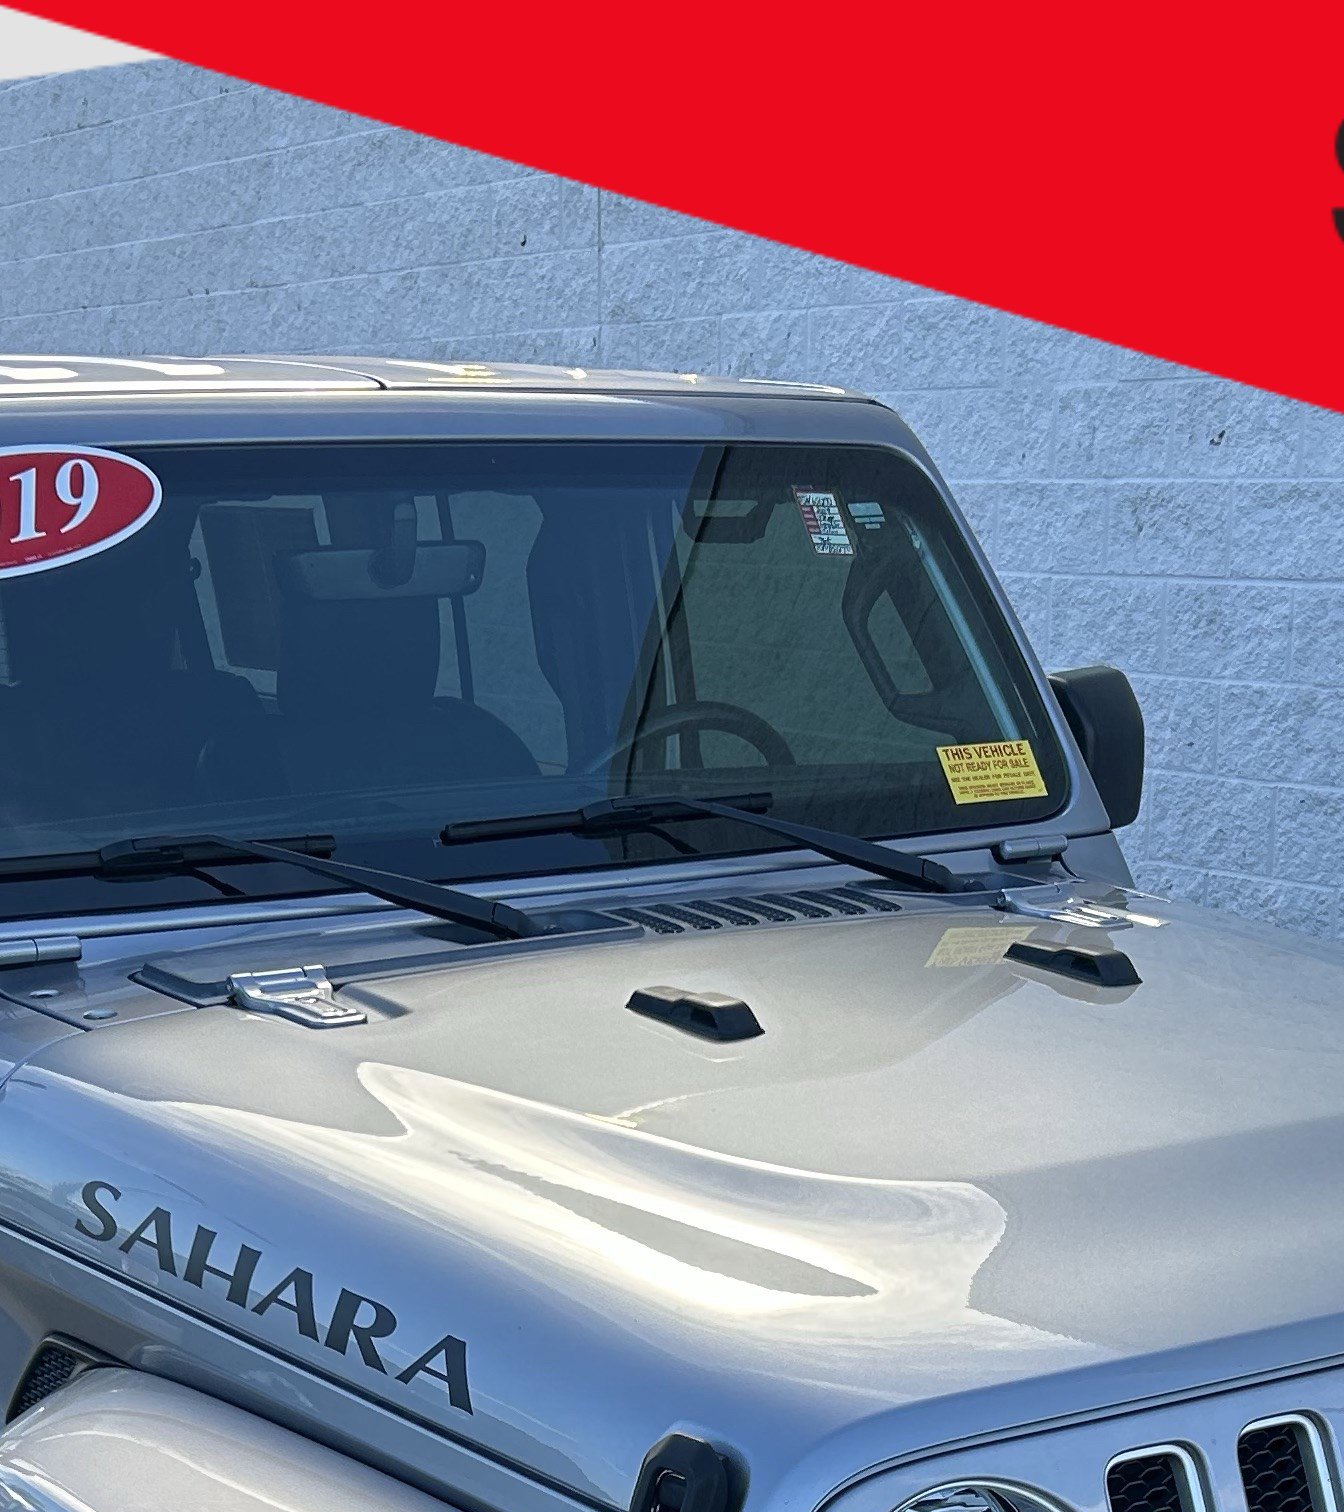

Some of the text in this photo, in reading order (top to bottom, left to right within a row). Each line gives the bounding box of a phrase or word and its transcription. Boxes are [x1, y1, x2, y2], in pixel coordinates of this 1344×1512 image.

[942, 743, 1027, 761] THIS VEHICLE
[74, 1180, 475, 1416] SAHARA
